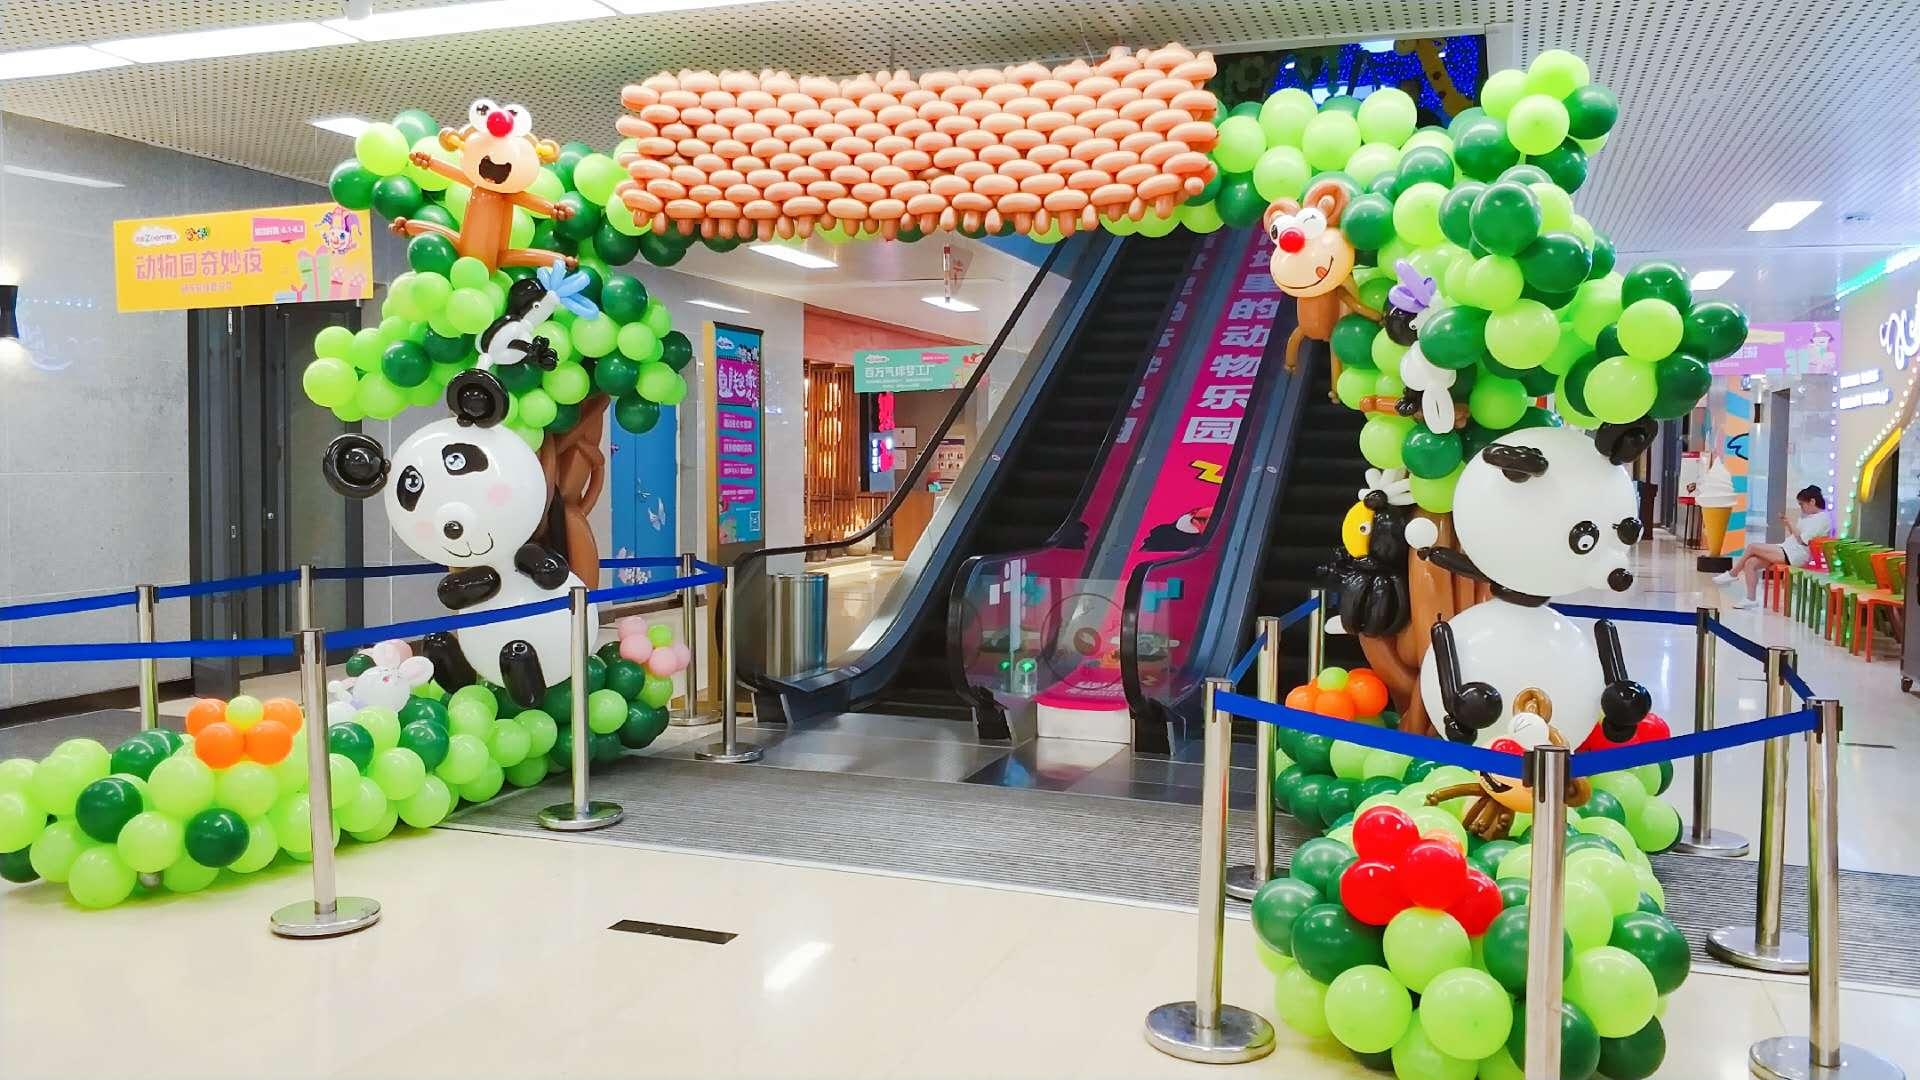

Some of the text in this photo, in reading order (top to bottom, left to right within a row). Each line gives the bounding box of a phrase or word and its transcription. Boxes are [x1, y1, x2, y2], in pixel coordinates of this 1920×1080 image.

[135, 248, 263, 280] 动物园奇妙夜
